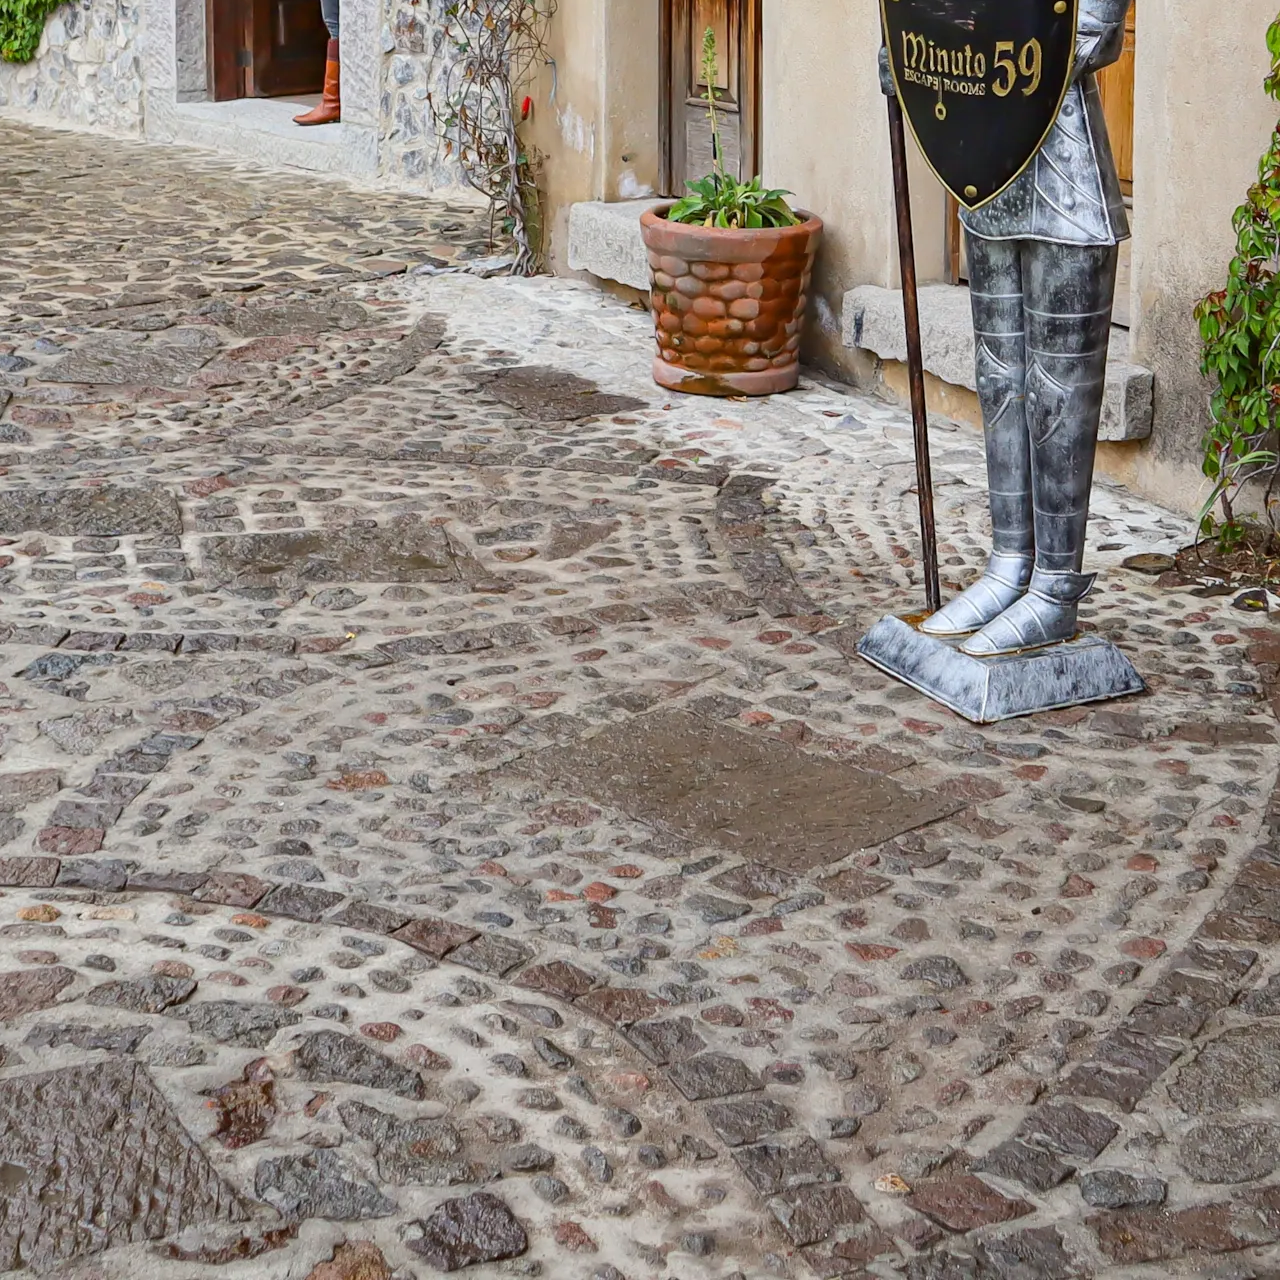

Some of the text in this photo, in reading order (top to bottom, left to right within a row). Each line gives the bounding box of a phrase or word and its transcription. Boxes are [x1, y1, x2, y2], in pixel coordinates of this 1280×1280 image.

[901, 30, 1042, 97] Minuto 59
[943, 78, 986, 96] ROOMS
